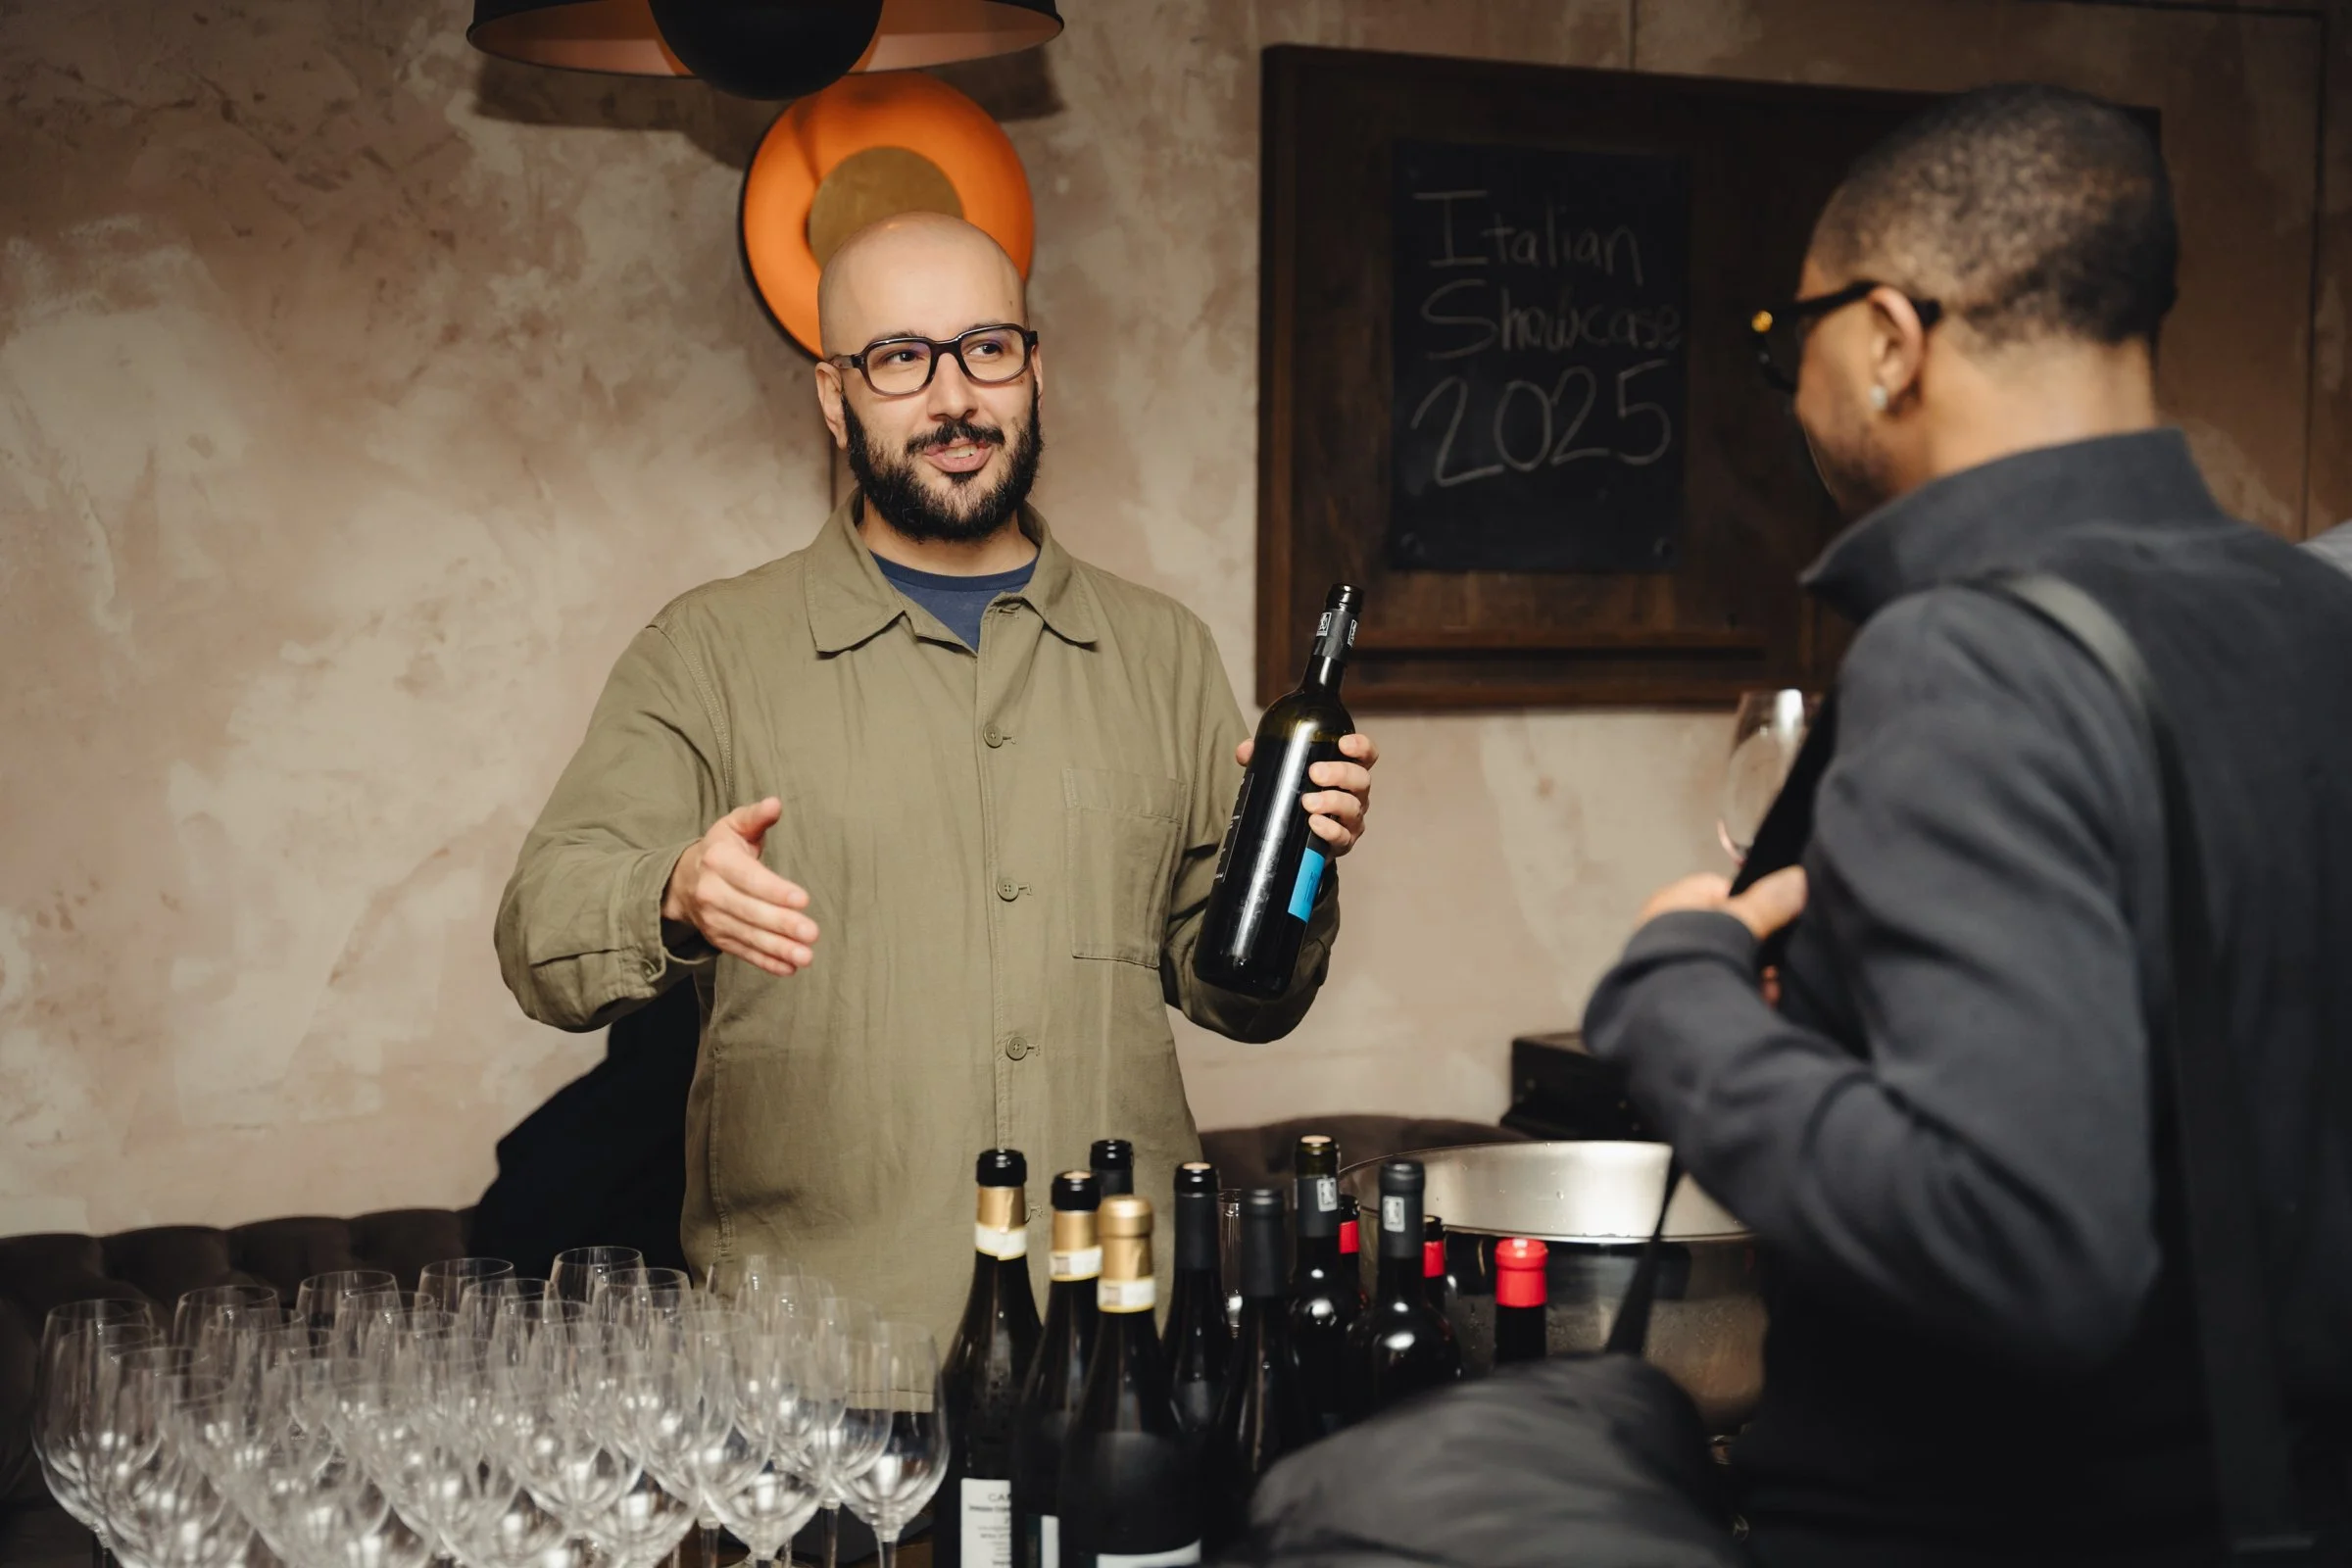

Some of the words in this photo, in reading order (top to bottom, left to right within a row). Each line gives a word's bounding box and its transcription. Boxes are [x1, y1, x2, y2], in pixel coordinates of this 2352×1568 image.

[1412, 189, 1644, 286] Italian
[1420, 277, 1682, 361] Showcase
[1410, 358, 1672, 487] 2025
